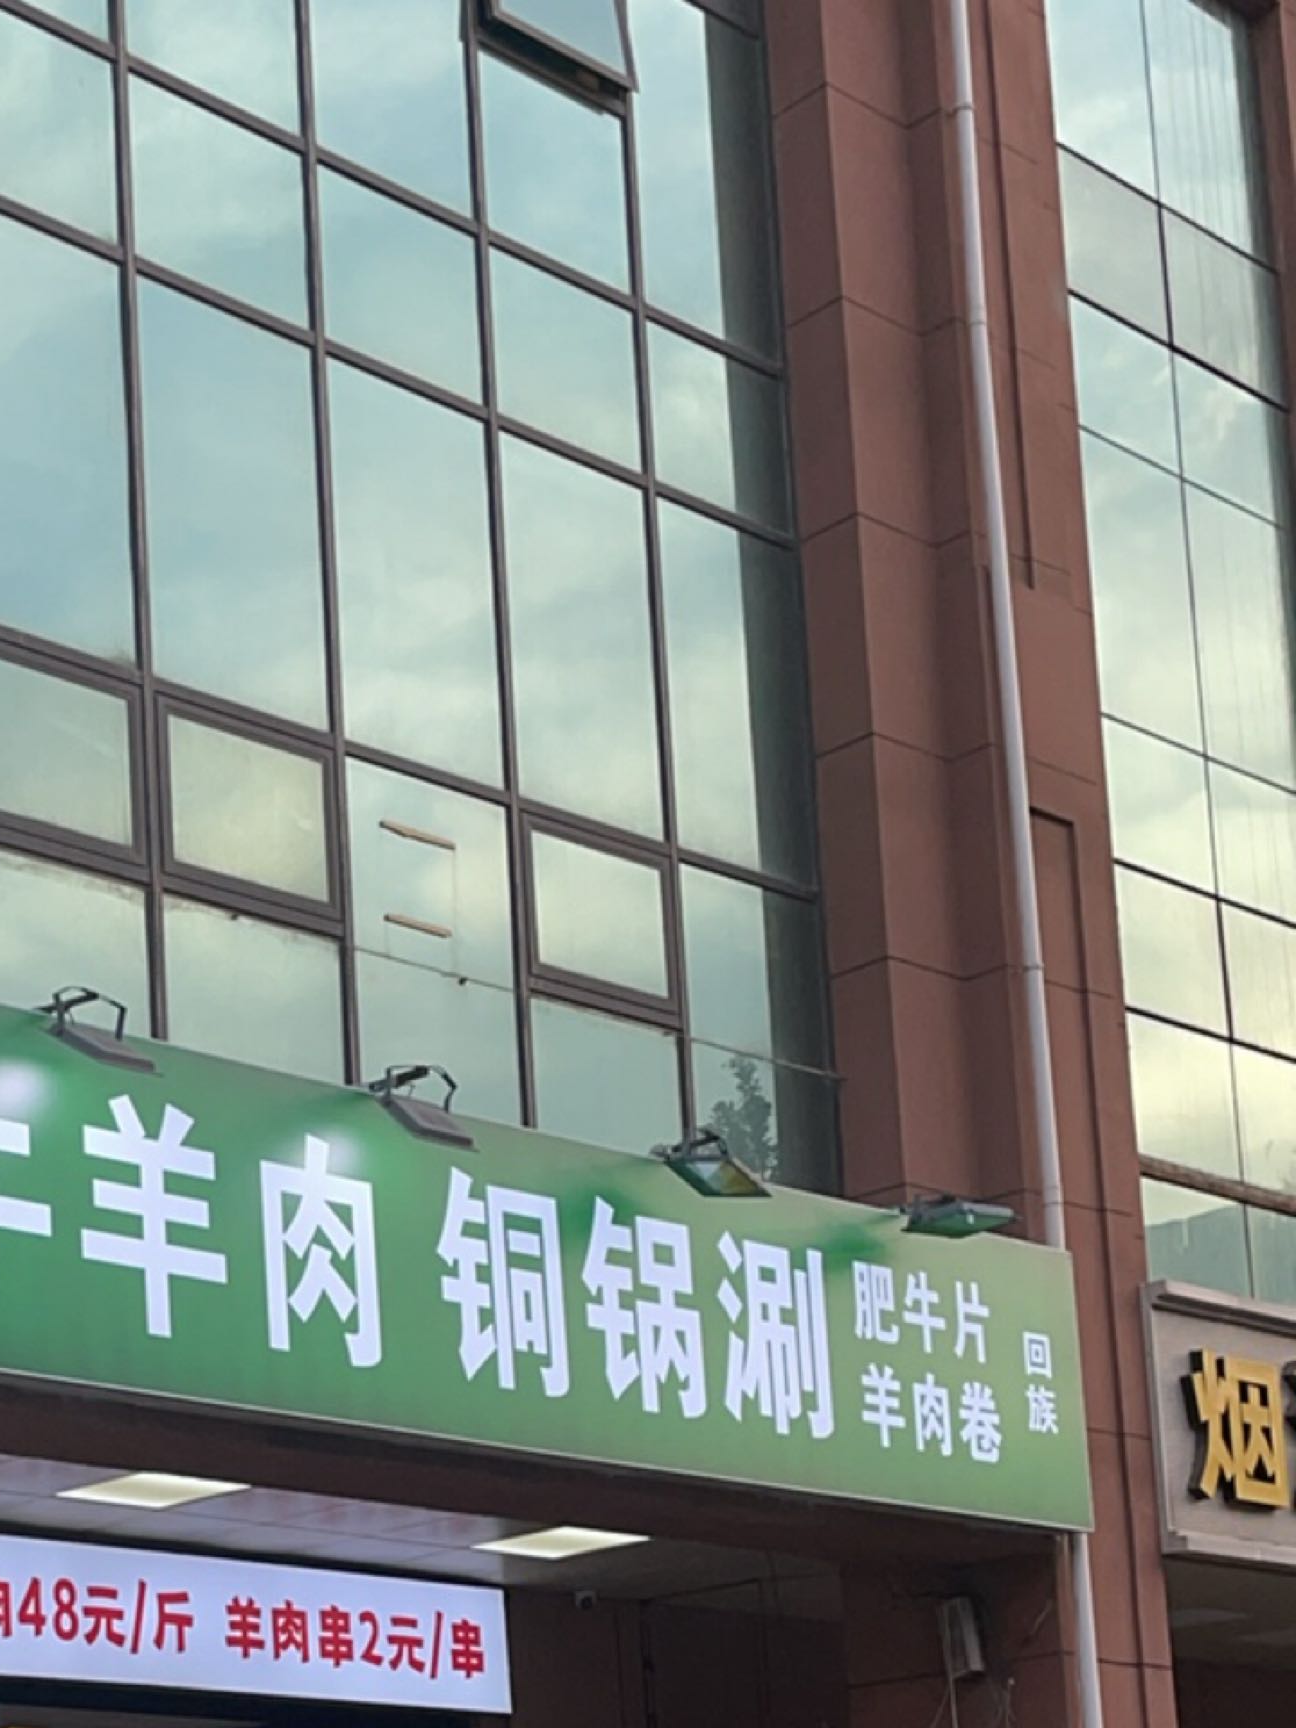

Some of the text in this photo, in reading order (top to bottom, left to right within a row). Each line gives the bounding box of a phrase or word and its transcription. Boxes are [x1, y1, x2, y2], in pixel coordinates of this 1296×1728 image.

[438, 1167, 835, 1439] 铜锅涮
[852, 1261, 988, 1366] 肥牛片
[862, 1366, 1003, 1465] 羊肉卷
[1023, 1331, 1059, 1437] 回族
[1194, 1348, 1296, 1510] 烟
[225, 1596, 484, 1679] 羊肉串2元/串
